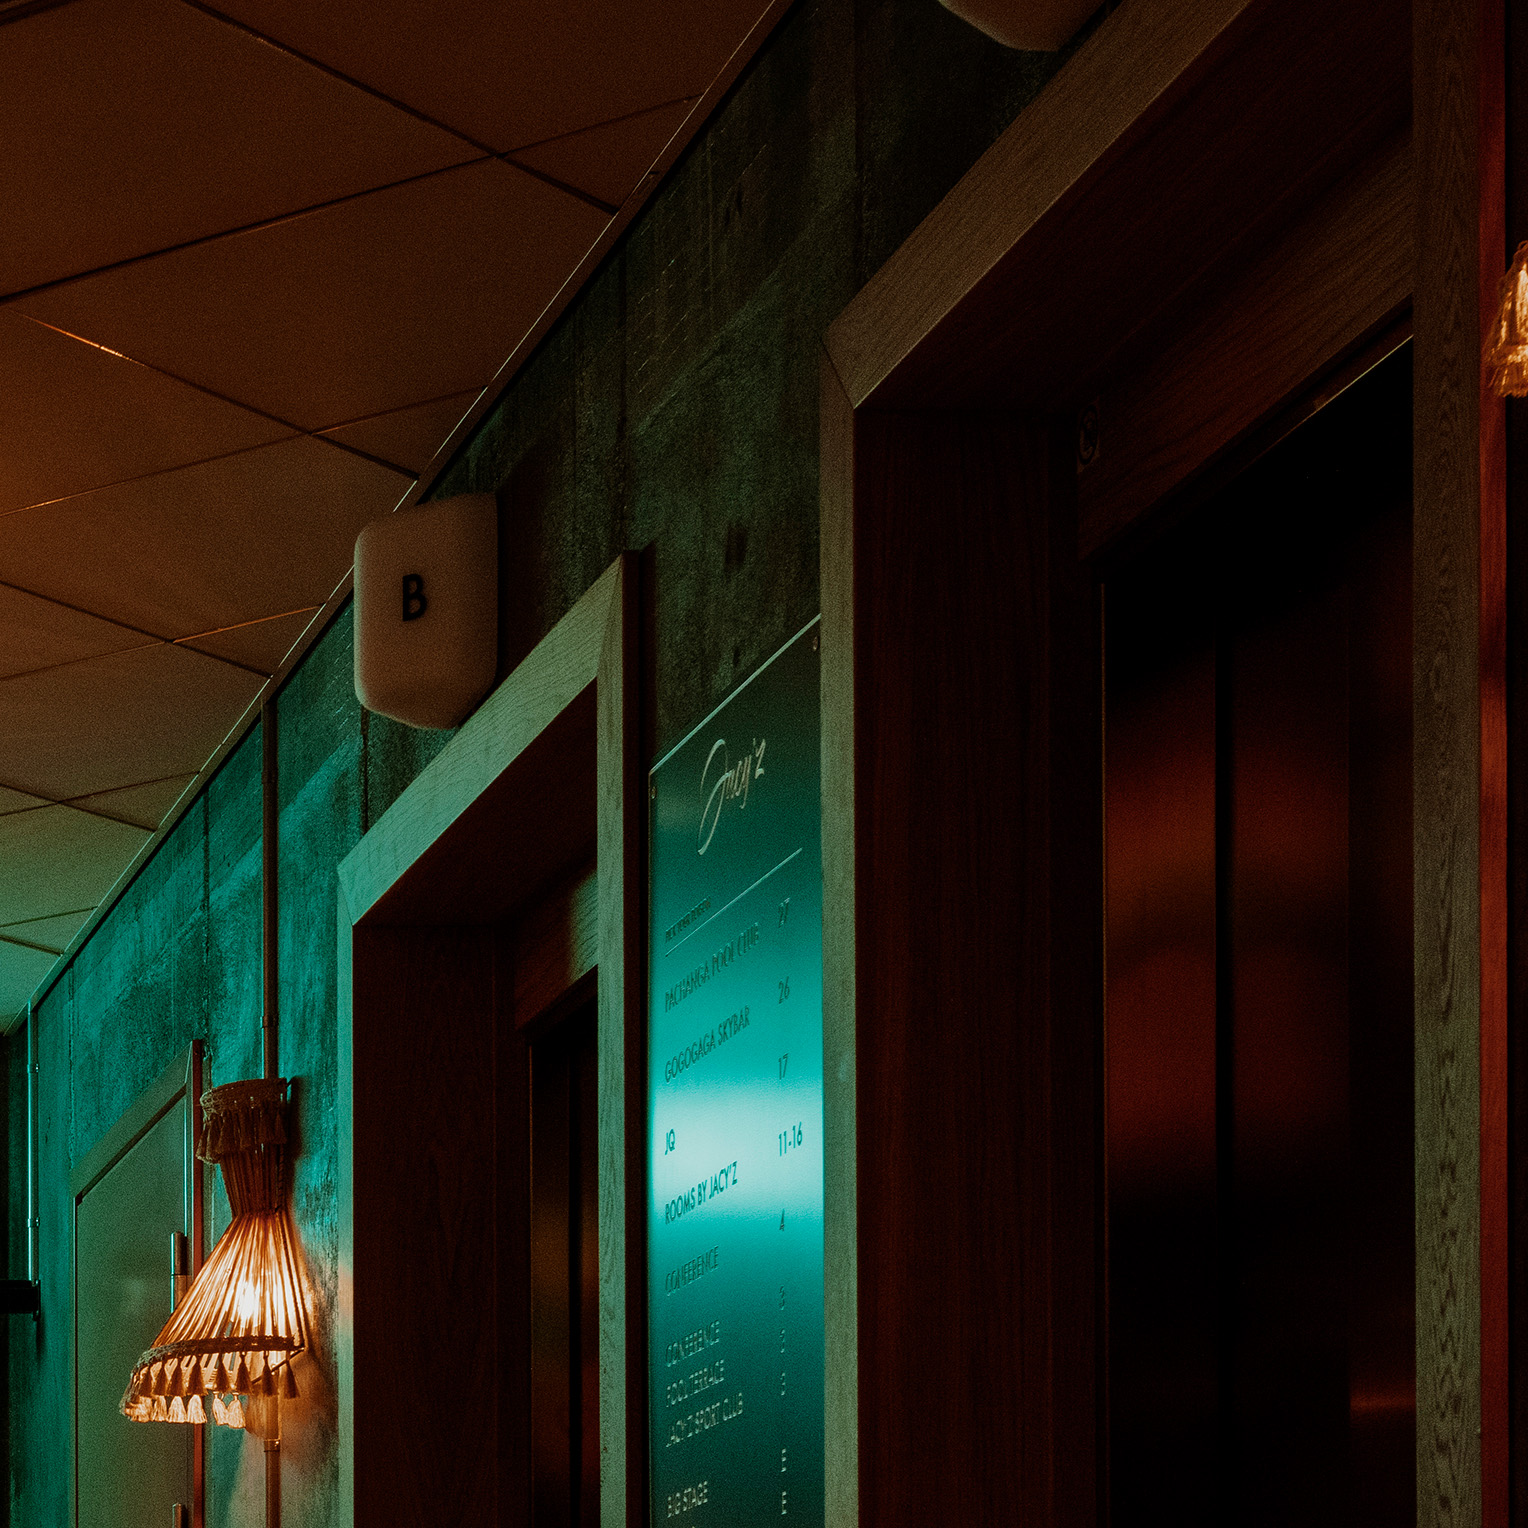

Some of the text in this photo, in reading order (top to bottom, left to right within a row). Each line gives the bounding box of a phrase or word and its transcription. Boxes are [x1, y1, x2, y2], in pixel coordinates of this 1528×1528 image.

[402, 573, 427, 622] B
[665, 976, 791, 1084] GOGOGAGA SKYBAR 26
[778, 1053, 789, 1081] 17
[665, 1121, 803, 1224] ROOMS BY JACY'Z 11-16
[665, 1245, 719, 1296] CONFERENCE
[665, 1320, 720, 1368] CONFERENCE
[682, 1480, 709, 1511] STAGE
